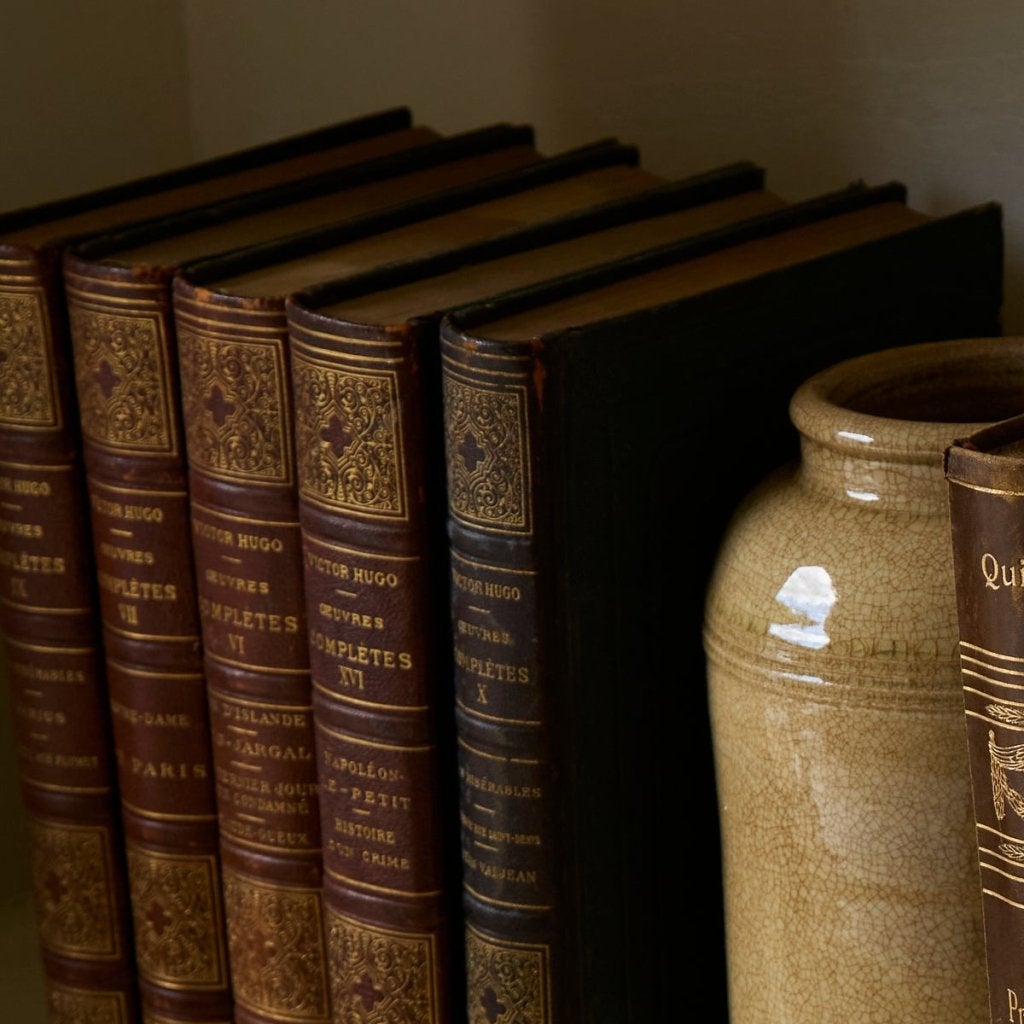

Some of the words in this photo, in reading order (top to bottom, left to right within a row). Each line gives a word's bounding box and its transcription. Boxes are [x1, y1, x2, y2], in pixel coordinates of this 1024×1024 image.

[124, 504, 164, 523] HUGO
[238, 532, 284, 553] HUGO
[353, 567, 399, 588] HUGO
[485, 581, 521, 601] HUGO
[319, 602, 385, 630] ŒUVRES
[227, 633, 247, 656] VI
[338, 665, 365, 691] XVI
[476, 682, 488, 704] X
[132, 757, 208, 779] PARIS
[335, 817, 396, 845] HISTOIRE
[361, 849, 411, 870] CRIME
